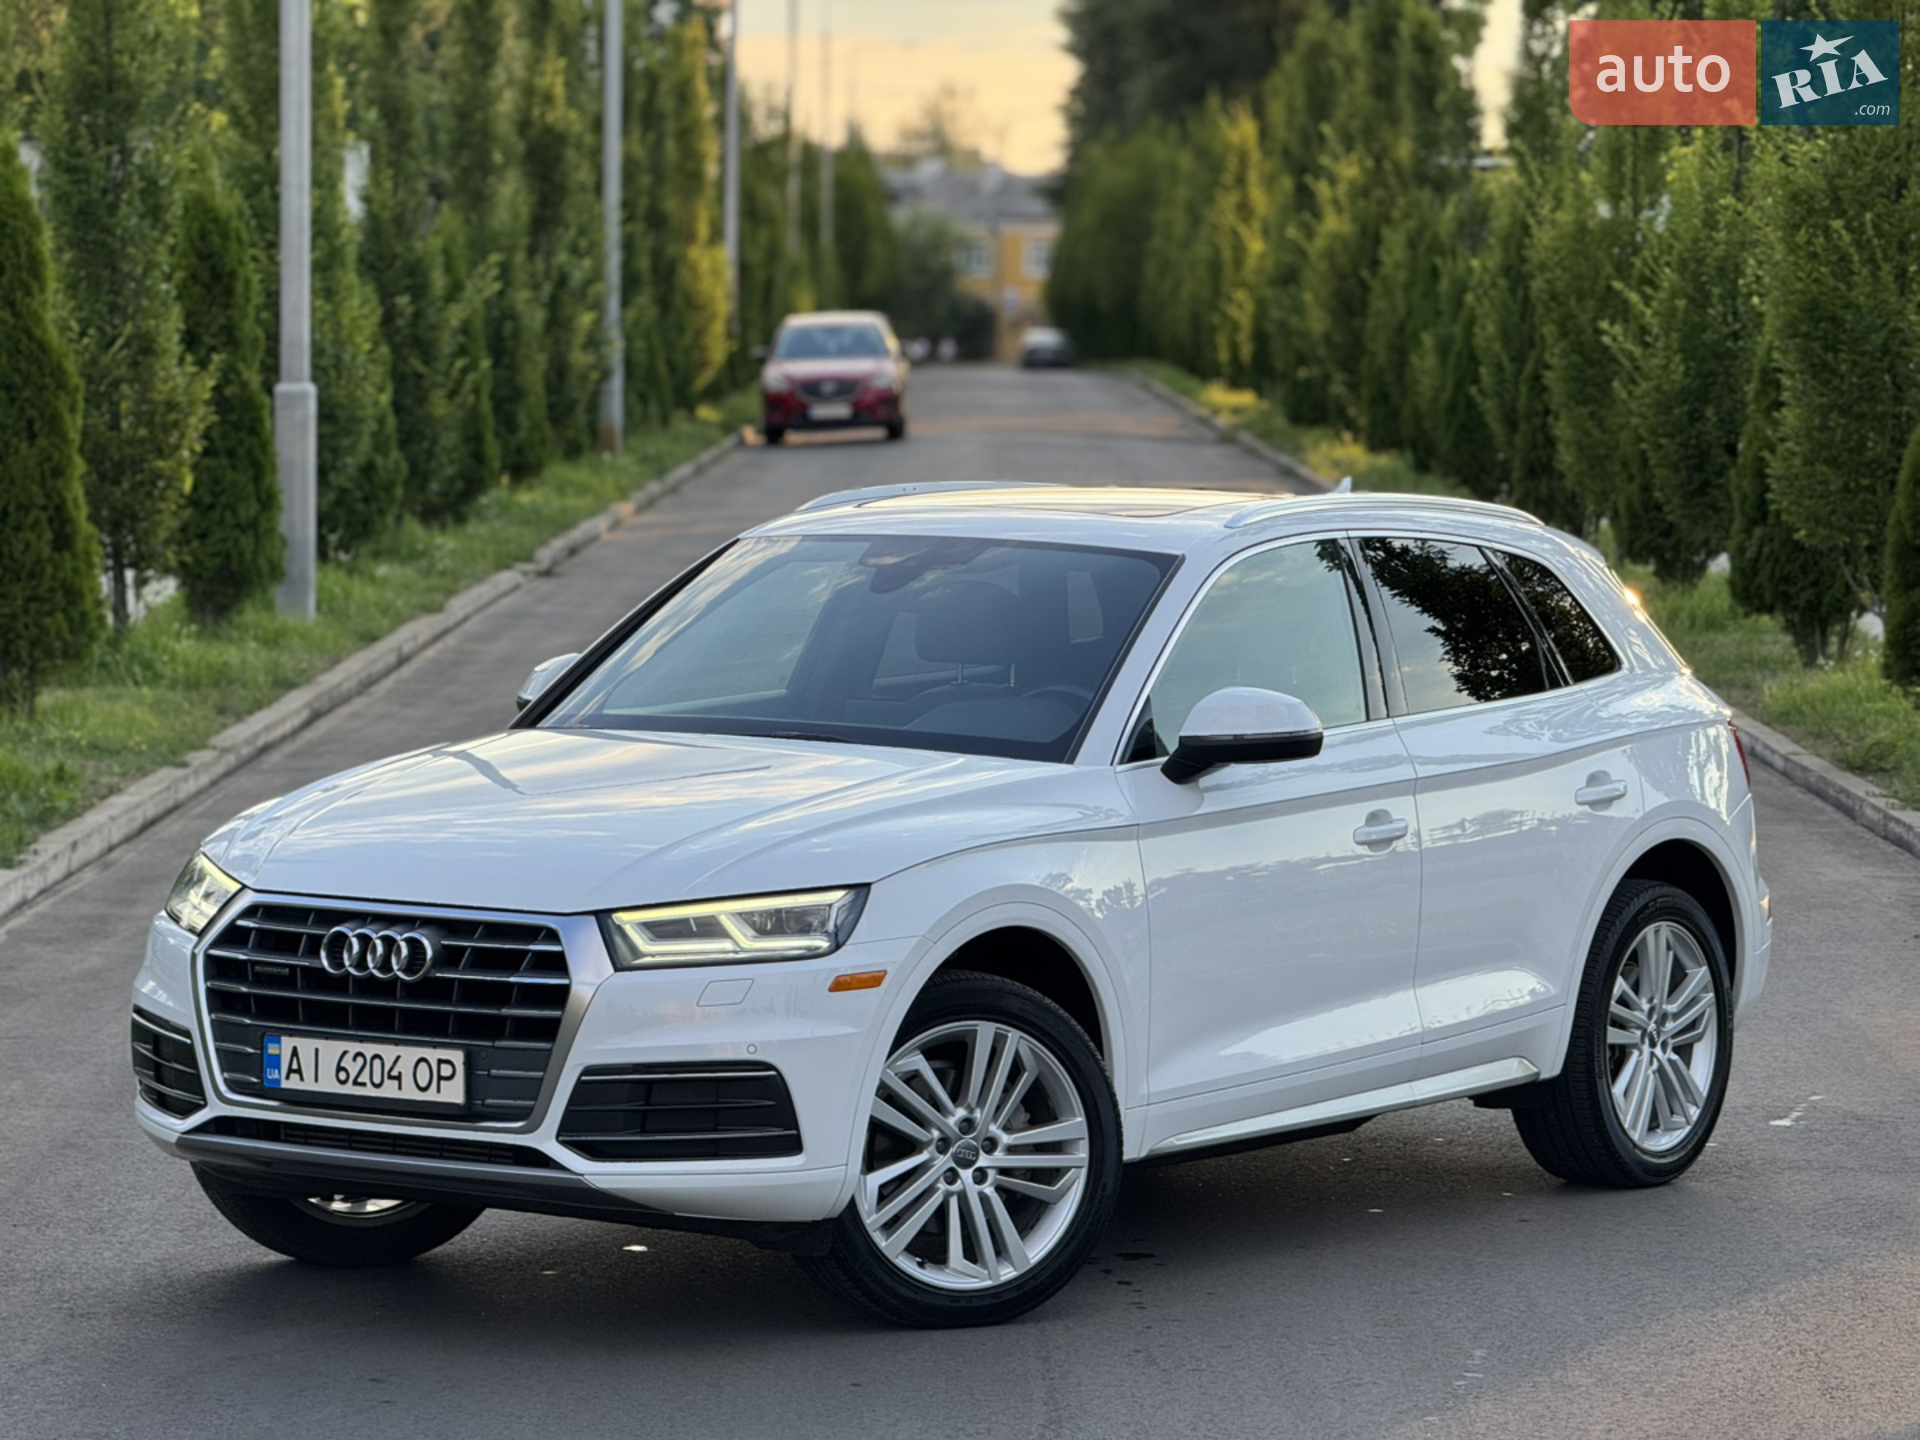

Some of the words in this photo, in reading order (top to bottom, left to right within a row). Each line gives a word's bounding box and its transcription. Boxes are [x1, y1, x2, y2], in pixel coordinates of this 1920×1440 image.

[266, 1068, 280, 1080] UA
[285, 1045, 319, 1083] AI
[335, 1050, 403, 1091] 6204
[413, 1056, 457, 1094] OP
